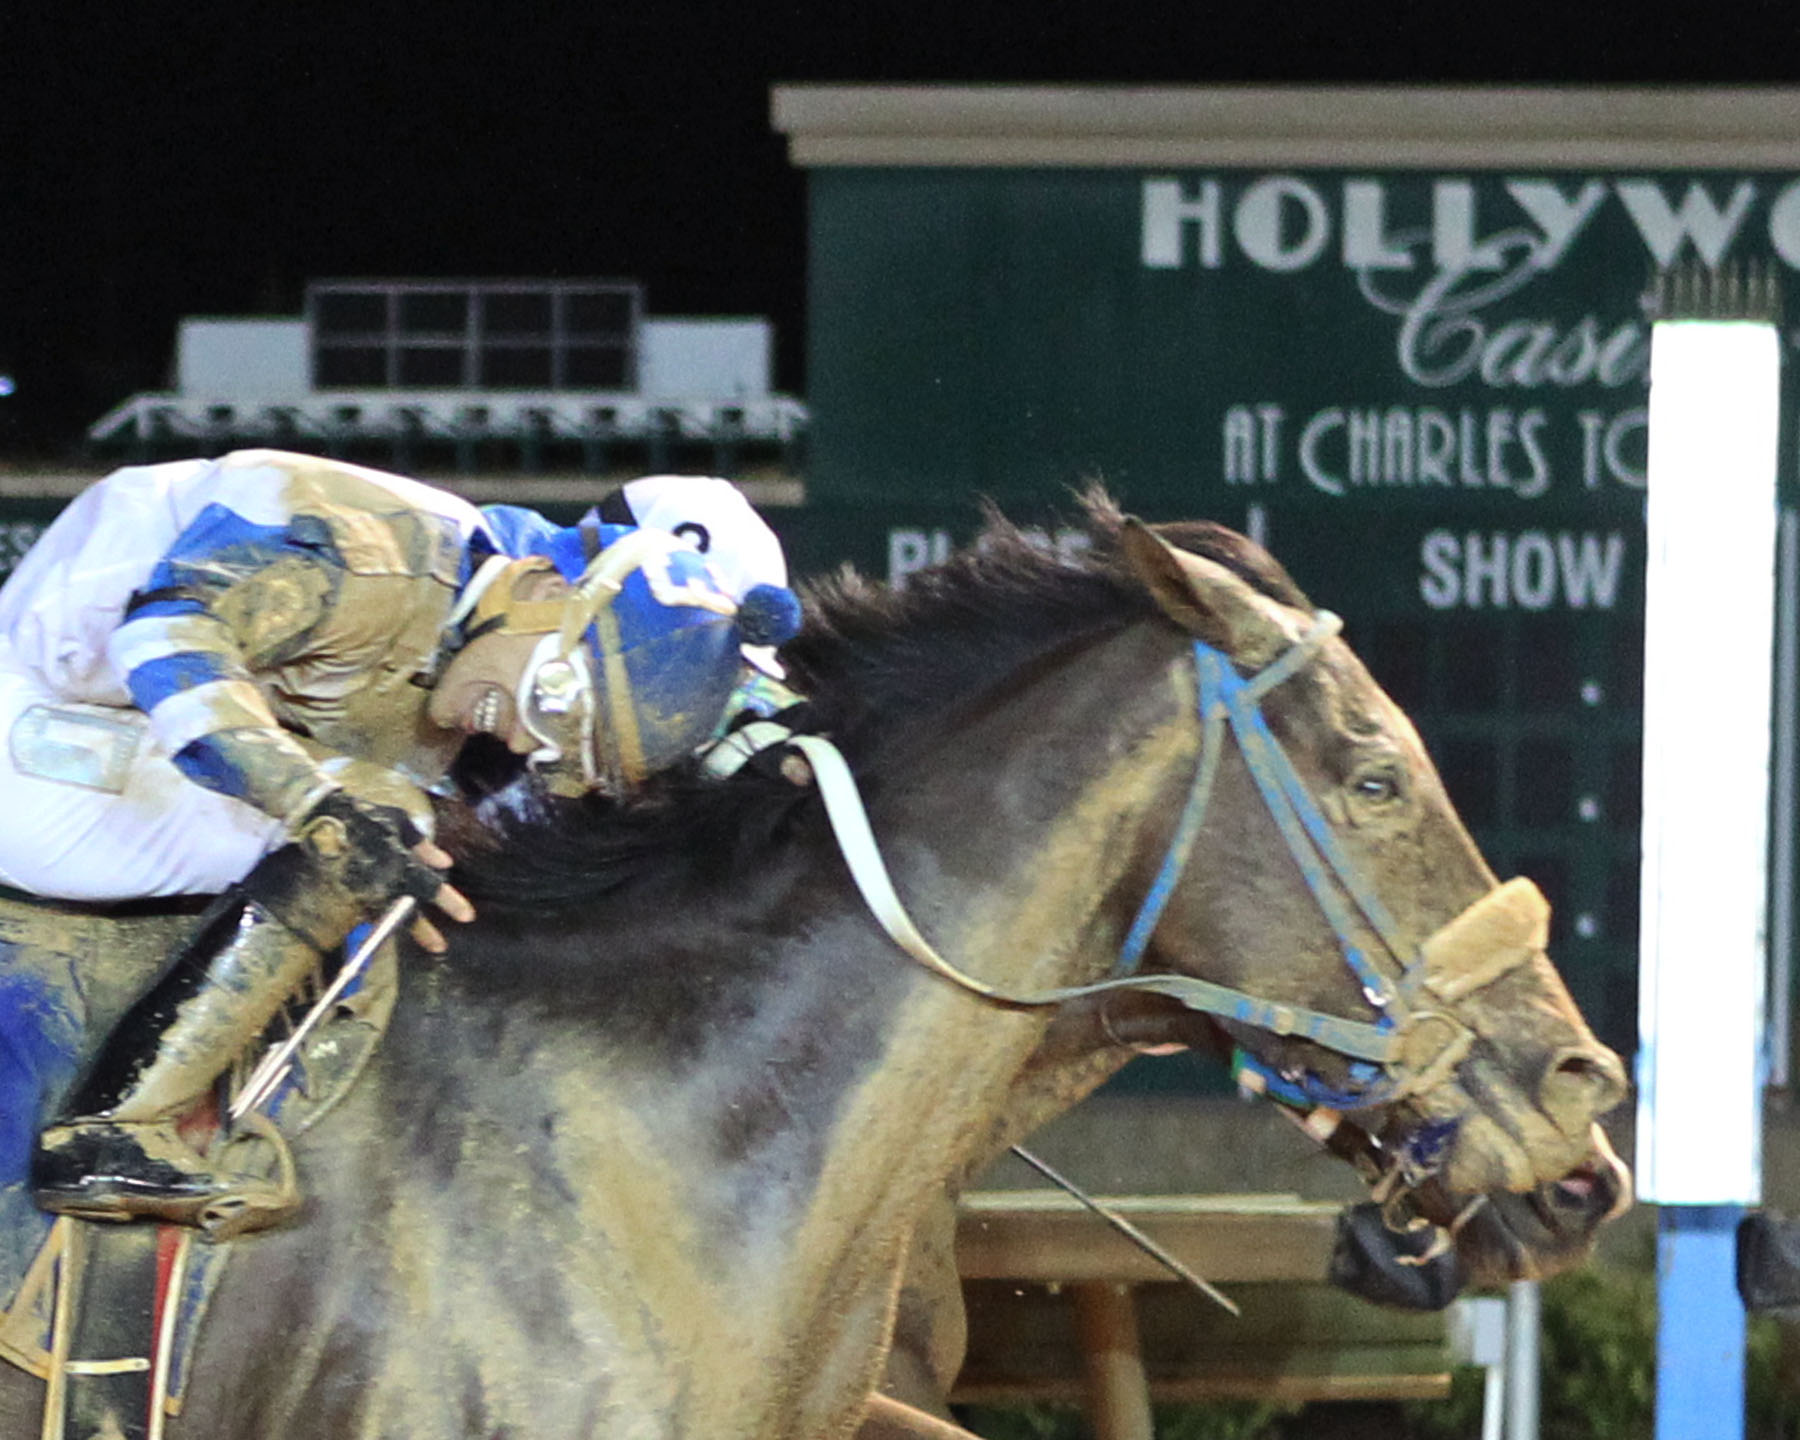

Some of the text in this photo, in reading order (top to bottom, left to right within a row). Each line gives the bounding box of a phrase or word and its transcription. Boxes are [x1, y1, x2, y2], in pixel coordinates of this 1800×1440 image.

[1221, 404, 1280, 484] AT
[1300, 406, 1550, 498] CHARLES
[1420, 530, 1624, 610] SHOW
